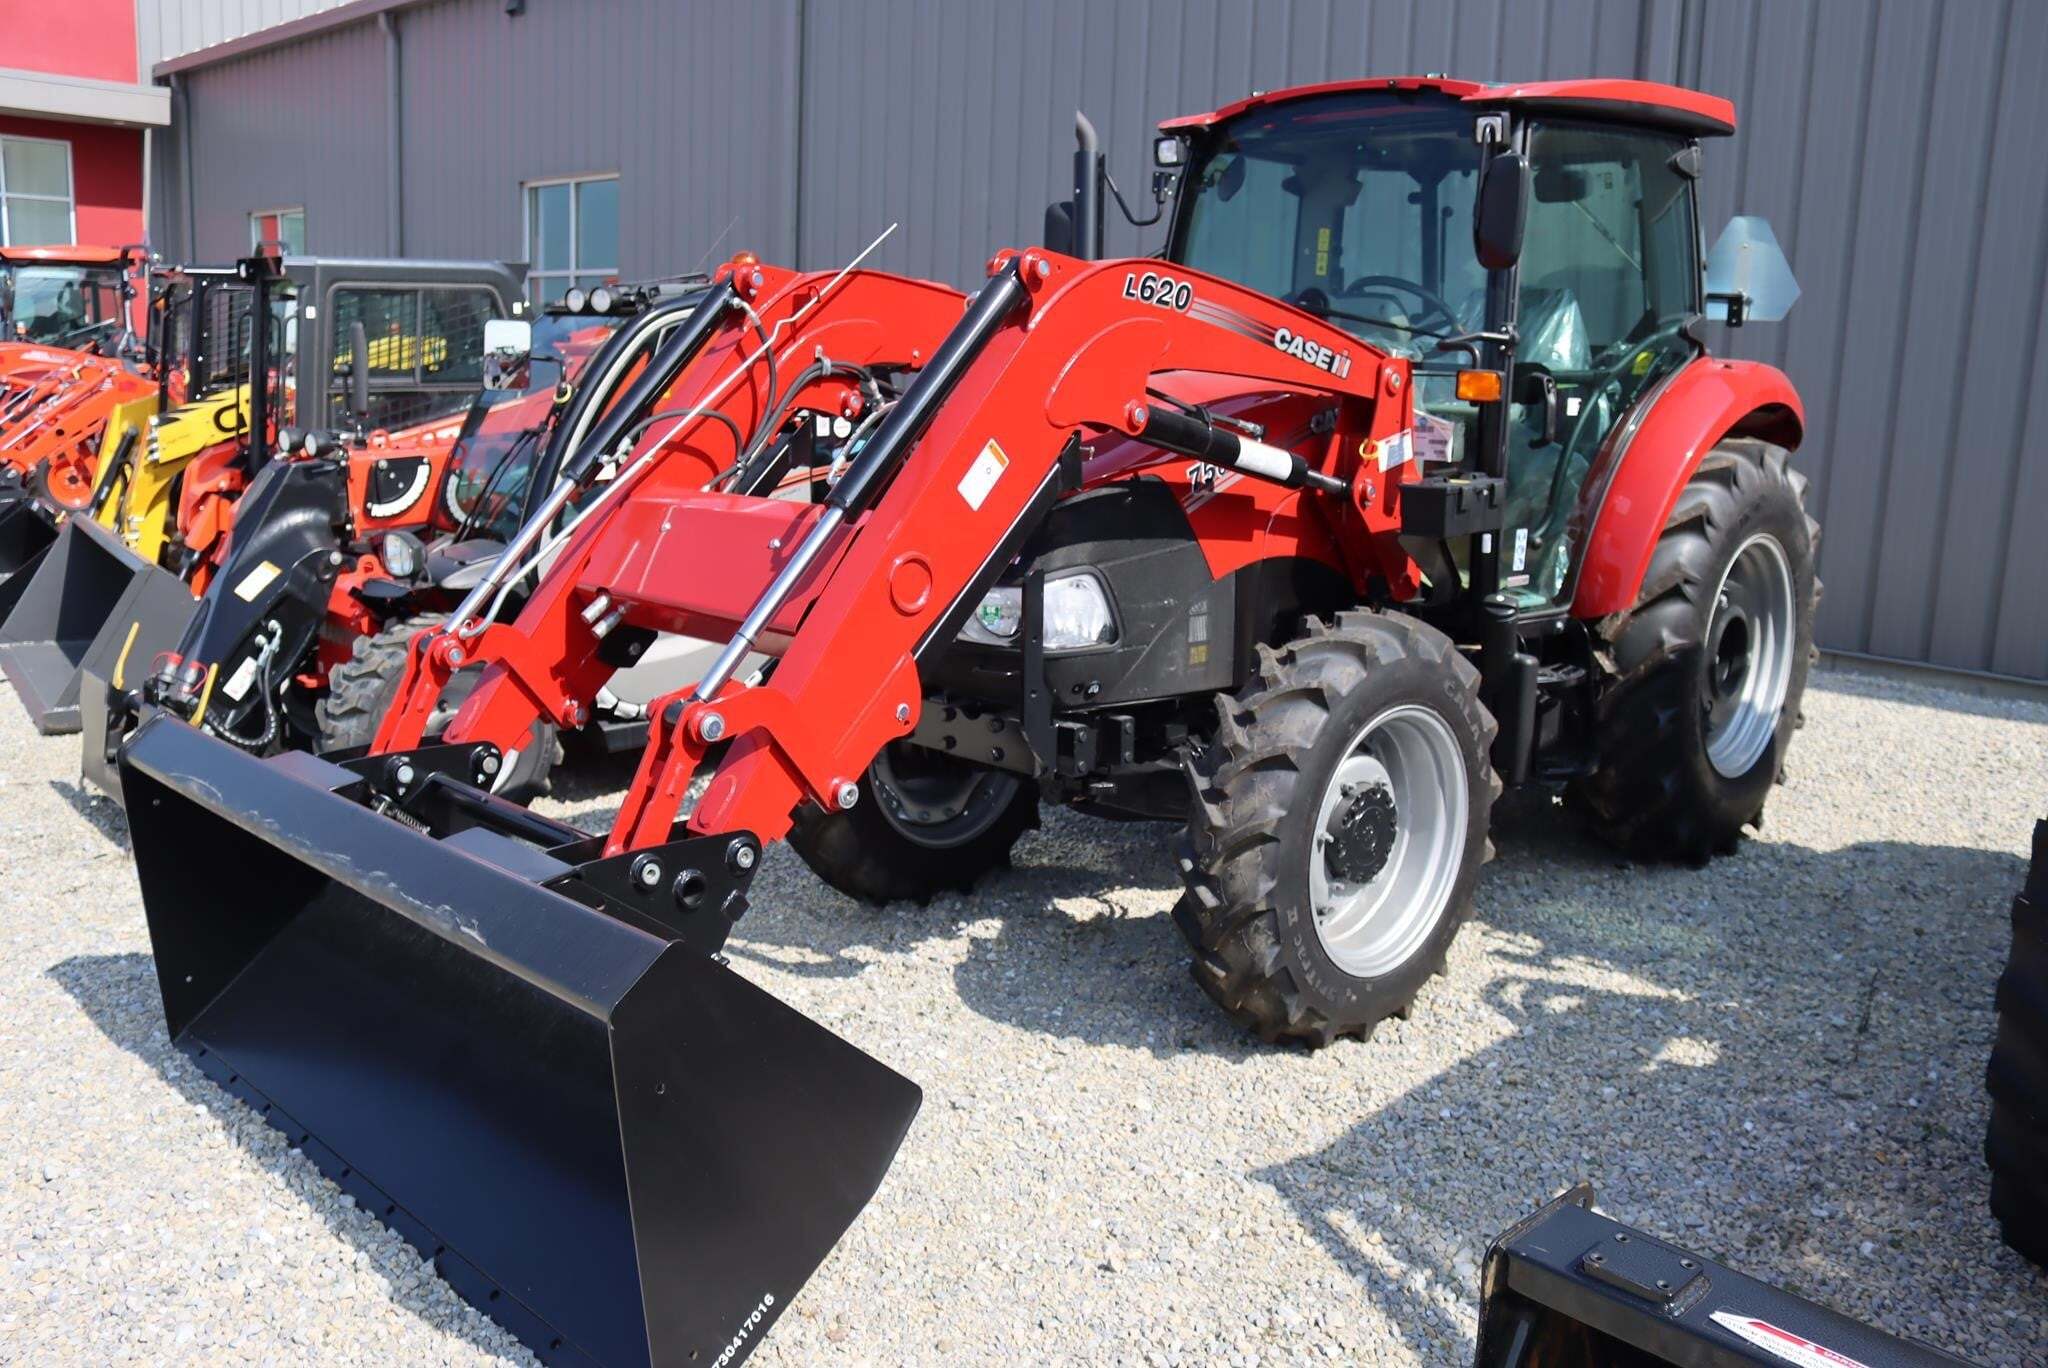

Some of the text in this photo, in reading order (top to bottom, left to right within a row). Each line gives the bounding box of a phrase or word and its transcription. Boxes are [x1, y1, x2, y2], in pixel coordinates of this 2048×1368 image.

[1122, 272, 1193, 313] L620
[1274, 327, 1333, 371] CASE
[1311, 407, 1341, 433] CA
